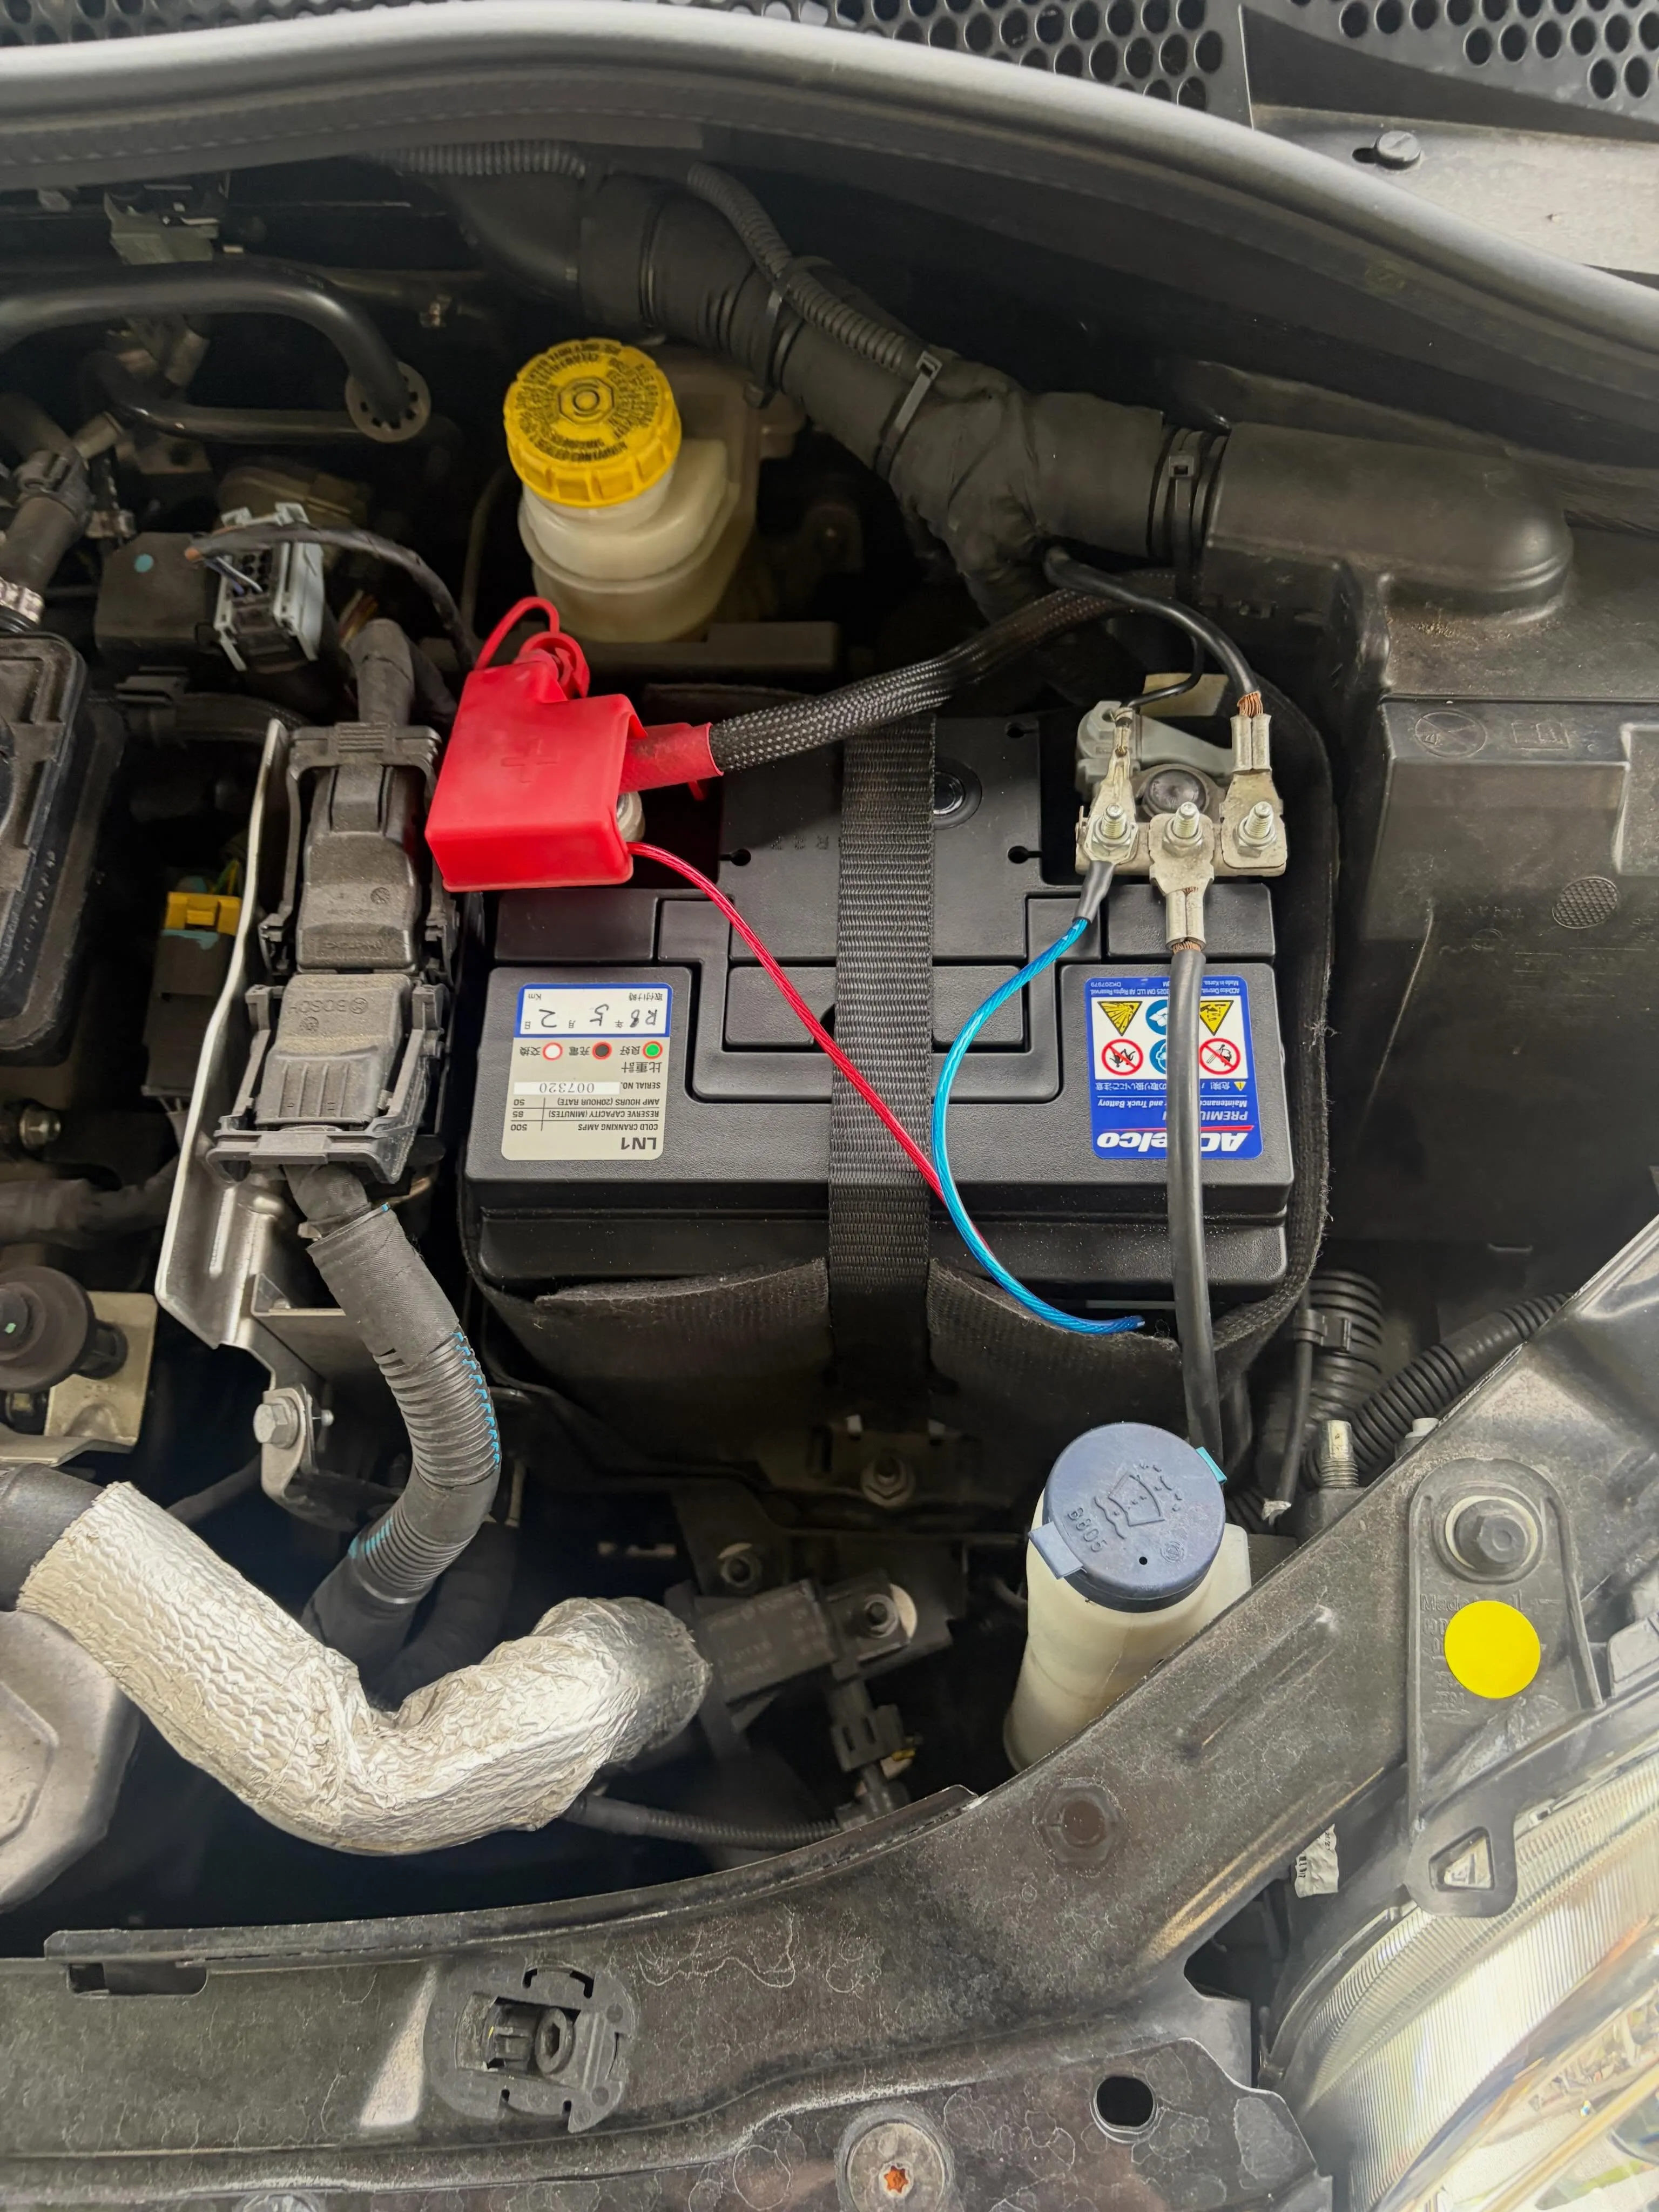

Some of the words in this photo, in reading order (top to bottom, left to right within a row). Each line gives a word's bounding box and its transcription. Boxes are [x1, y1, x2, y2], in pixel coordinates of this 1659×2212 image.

[538, 1009, 557, 1028] 2
[589, 1003, 610, 1026] 5
[568, 1020, 576, 1028] 月
[520, 1047, 540, 1056] 交換
[569, 1047, 590, 1056] 充電
[620, 1046, 640, 1055] 良好
[622, 1061, 662, 1073] 比重計
[539, 1082, 595, 1093] 007320
[557, 1098, 578, 1106] RATE)
[581, 1098, 613, 1106] (20HOUR
[549, 1110, 588, 1118] (MINUTES)
[1200, 1111, 1248, 1120] PREMIU
[621, 1137, 657, 1150] LN1
[1097, 1132, 1248, 1152] ACelco
